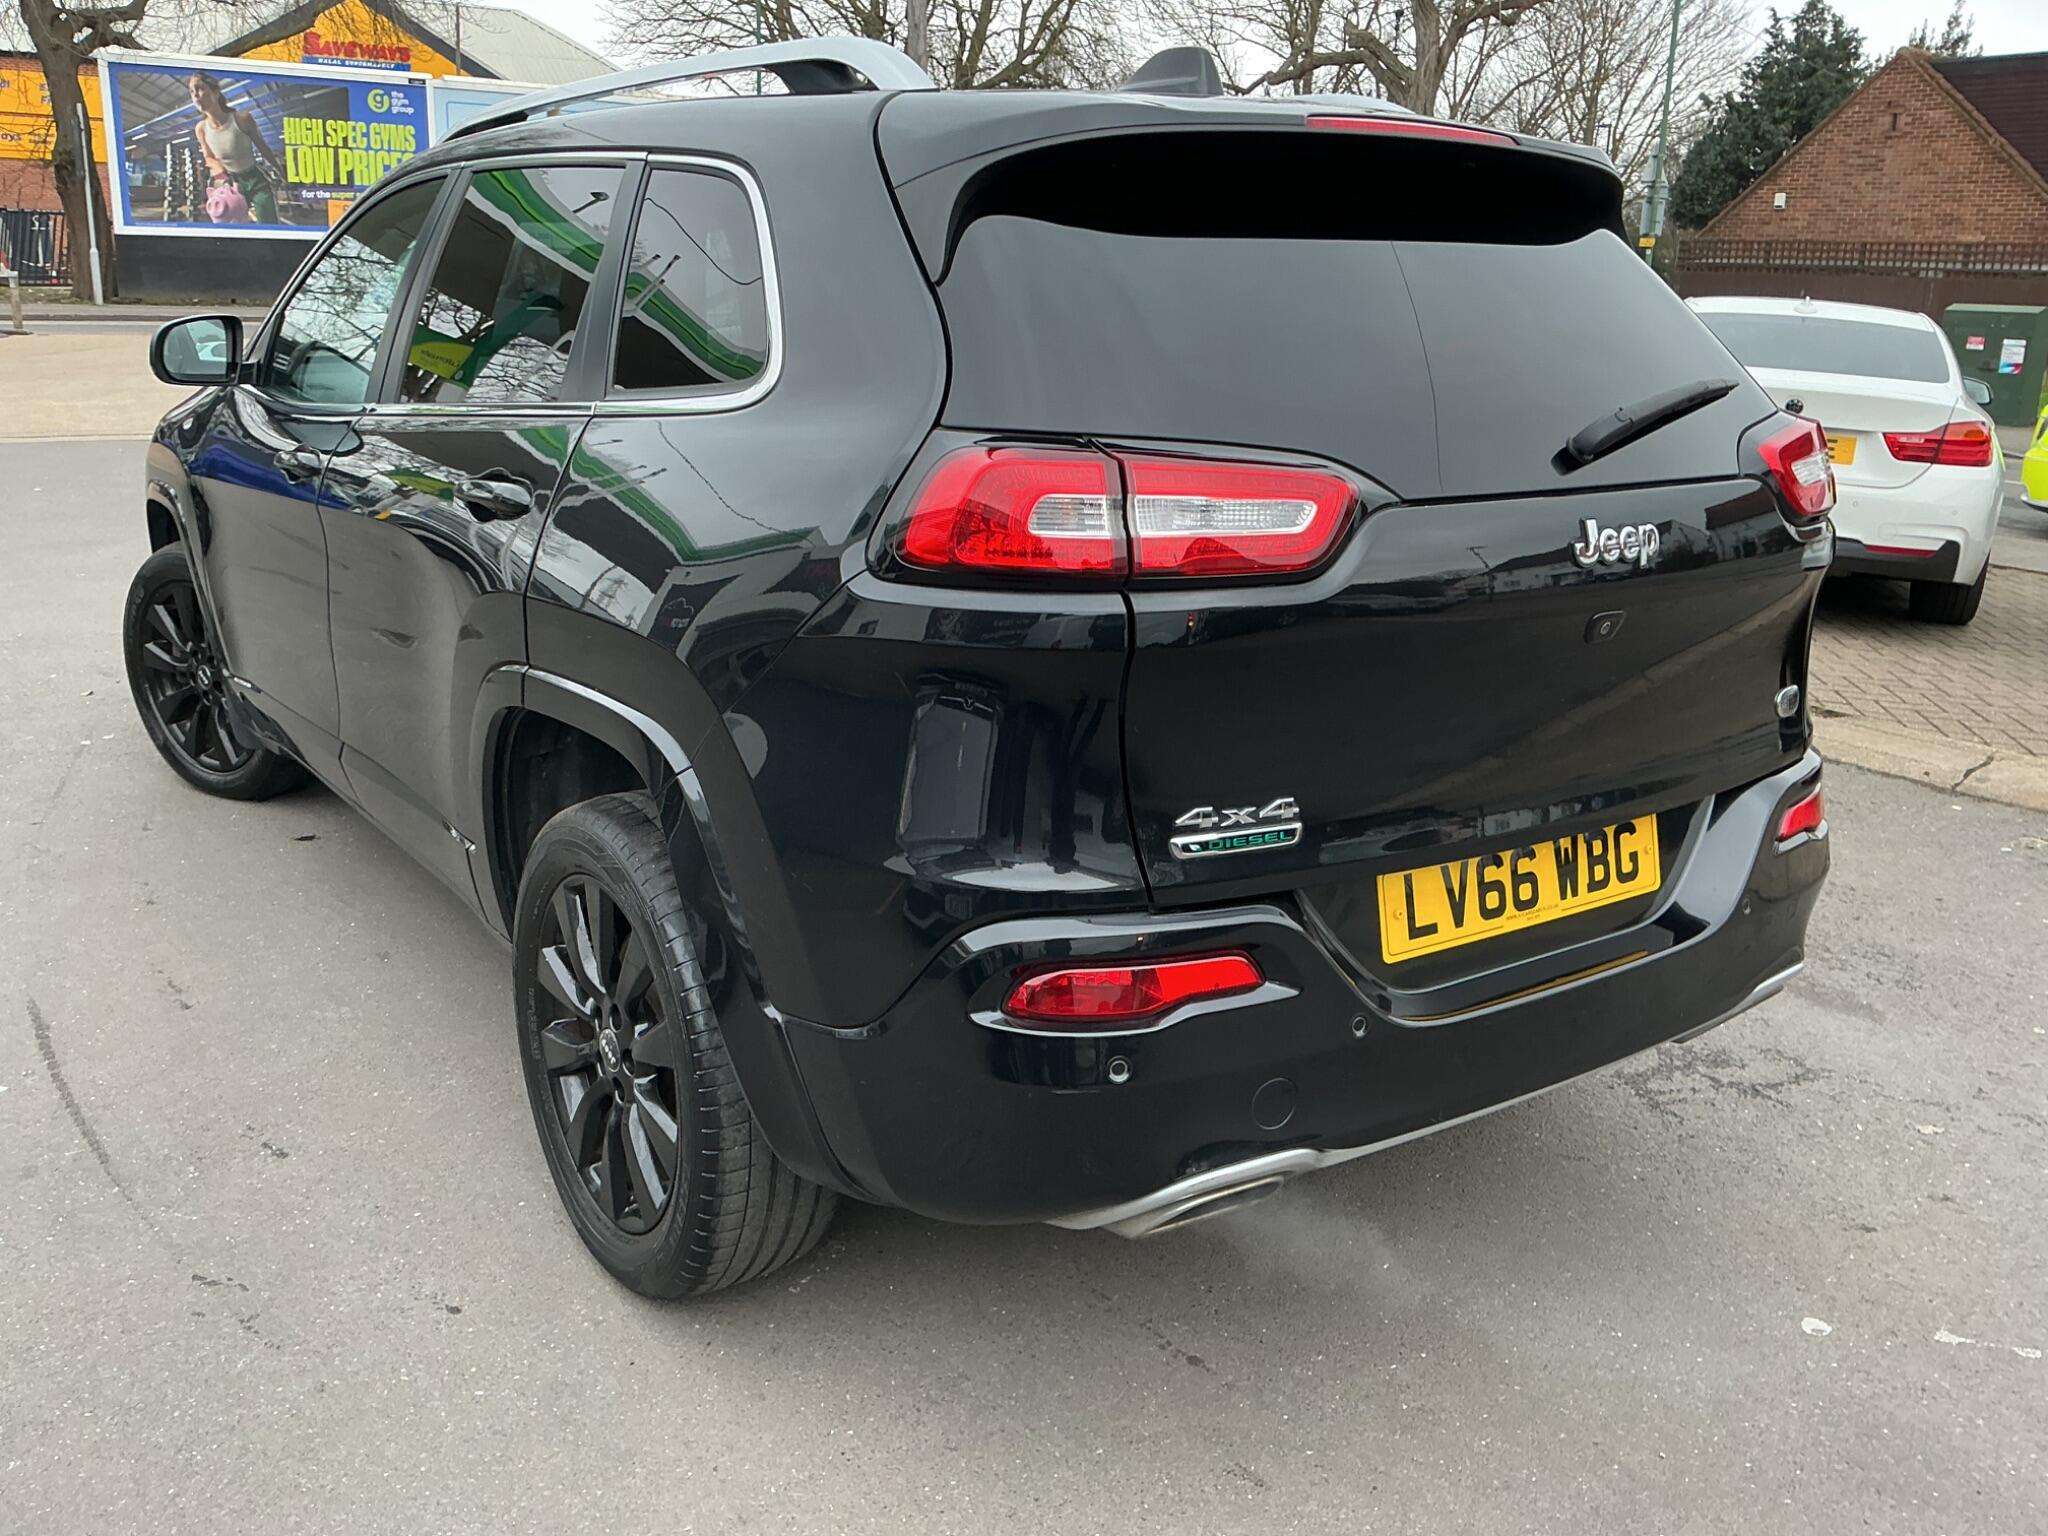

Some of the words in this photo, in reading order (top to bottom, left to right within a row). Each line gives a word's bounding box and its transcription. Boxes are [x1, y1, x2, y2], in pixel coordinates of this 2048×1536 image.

[391, 90, 404, 99] the
[391, 98, 410, 107] gym
[391, 106, 415, 116] group
[283, 117, 324, 145] HIGH
[325, 120, 367, 149] SPEC
[370, 122, 417, 153] GYMS
[285, 145, 335, 185] LOW
[338, 148, 416, 187] PRICE
[301, 190, 316, 199] for
[316, 190, 331, 199] the
[1572, 518, 1660, 569] Jeep
[1175, 797, 1300, 829] 4x4
[1209, 831, 1293, 850] DIESEL
[1403, 844, 1540, 940] LV66
[1554, 820, 1641, 901] WBG
